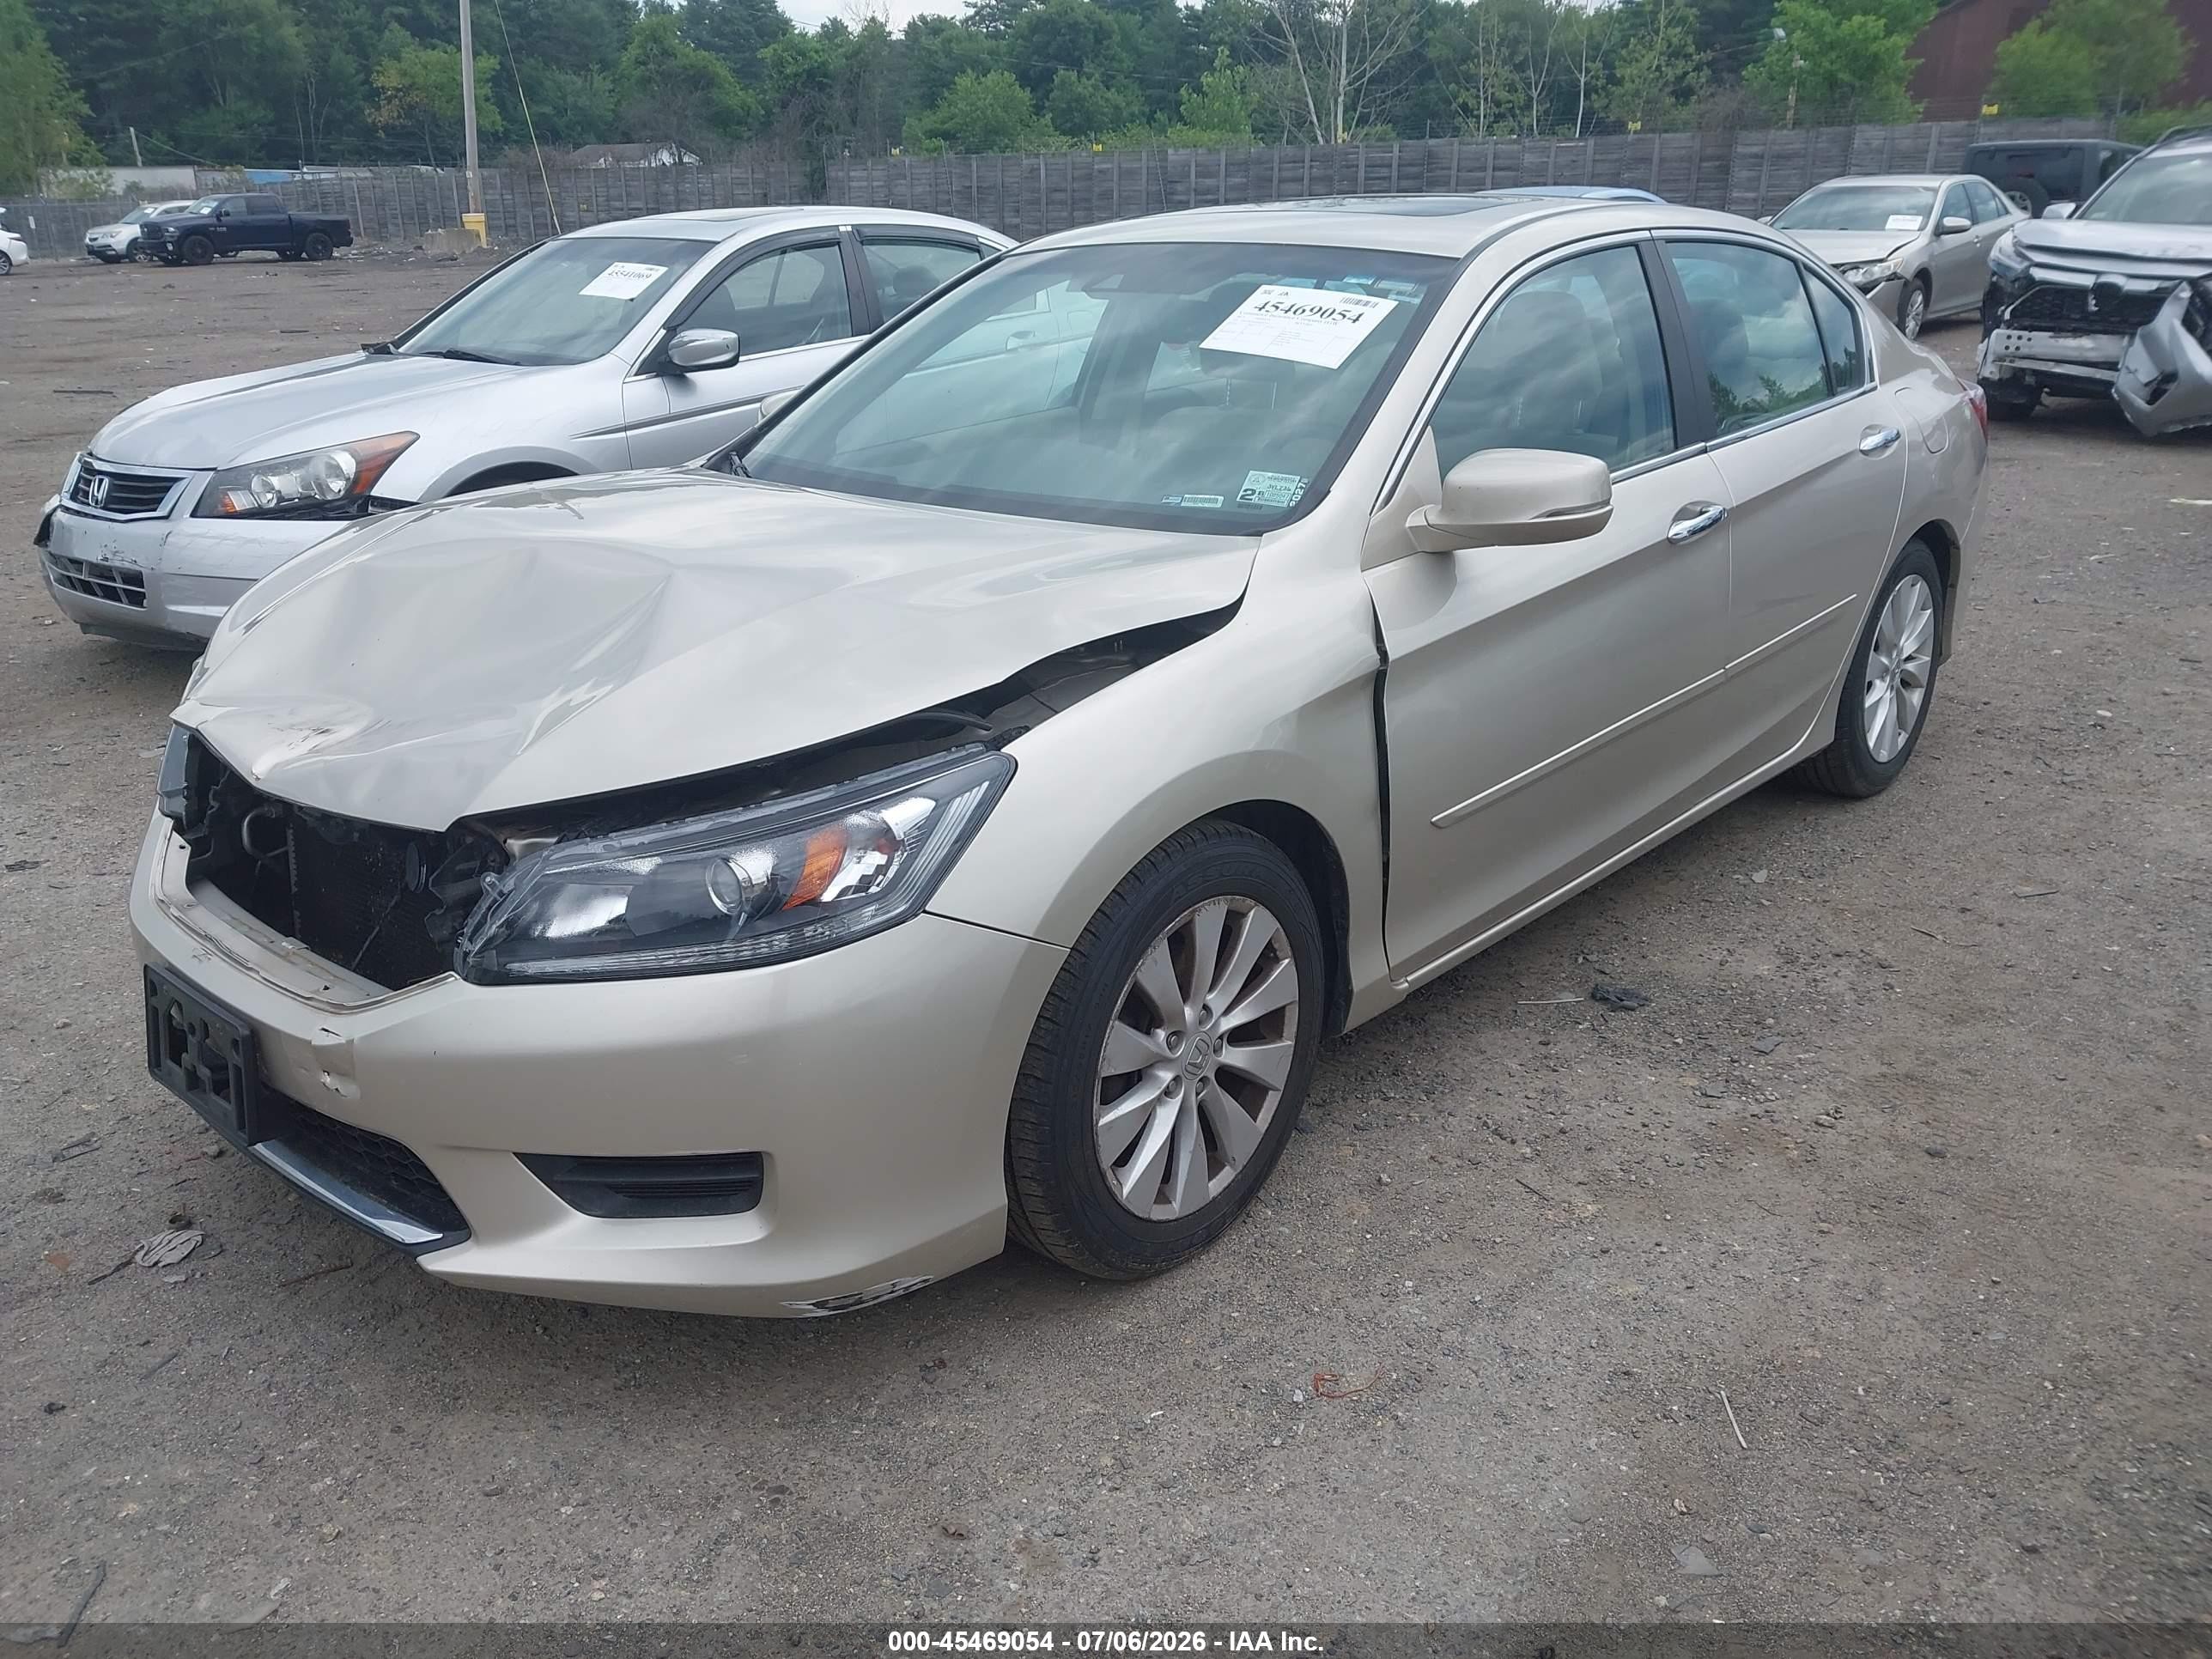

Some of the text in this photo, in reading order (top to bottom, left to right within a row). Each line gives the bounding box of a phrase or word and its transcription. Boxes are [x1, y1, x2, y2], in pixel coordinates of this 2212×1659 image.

[1254, 301, 1364, 324] 45469054
[1239, 488, 1257, 501] 2
[1289, 483, 1306, 507] 2027
